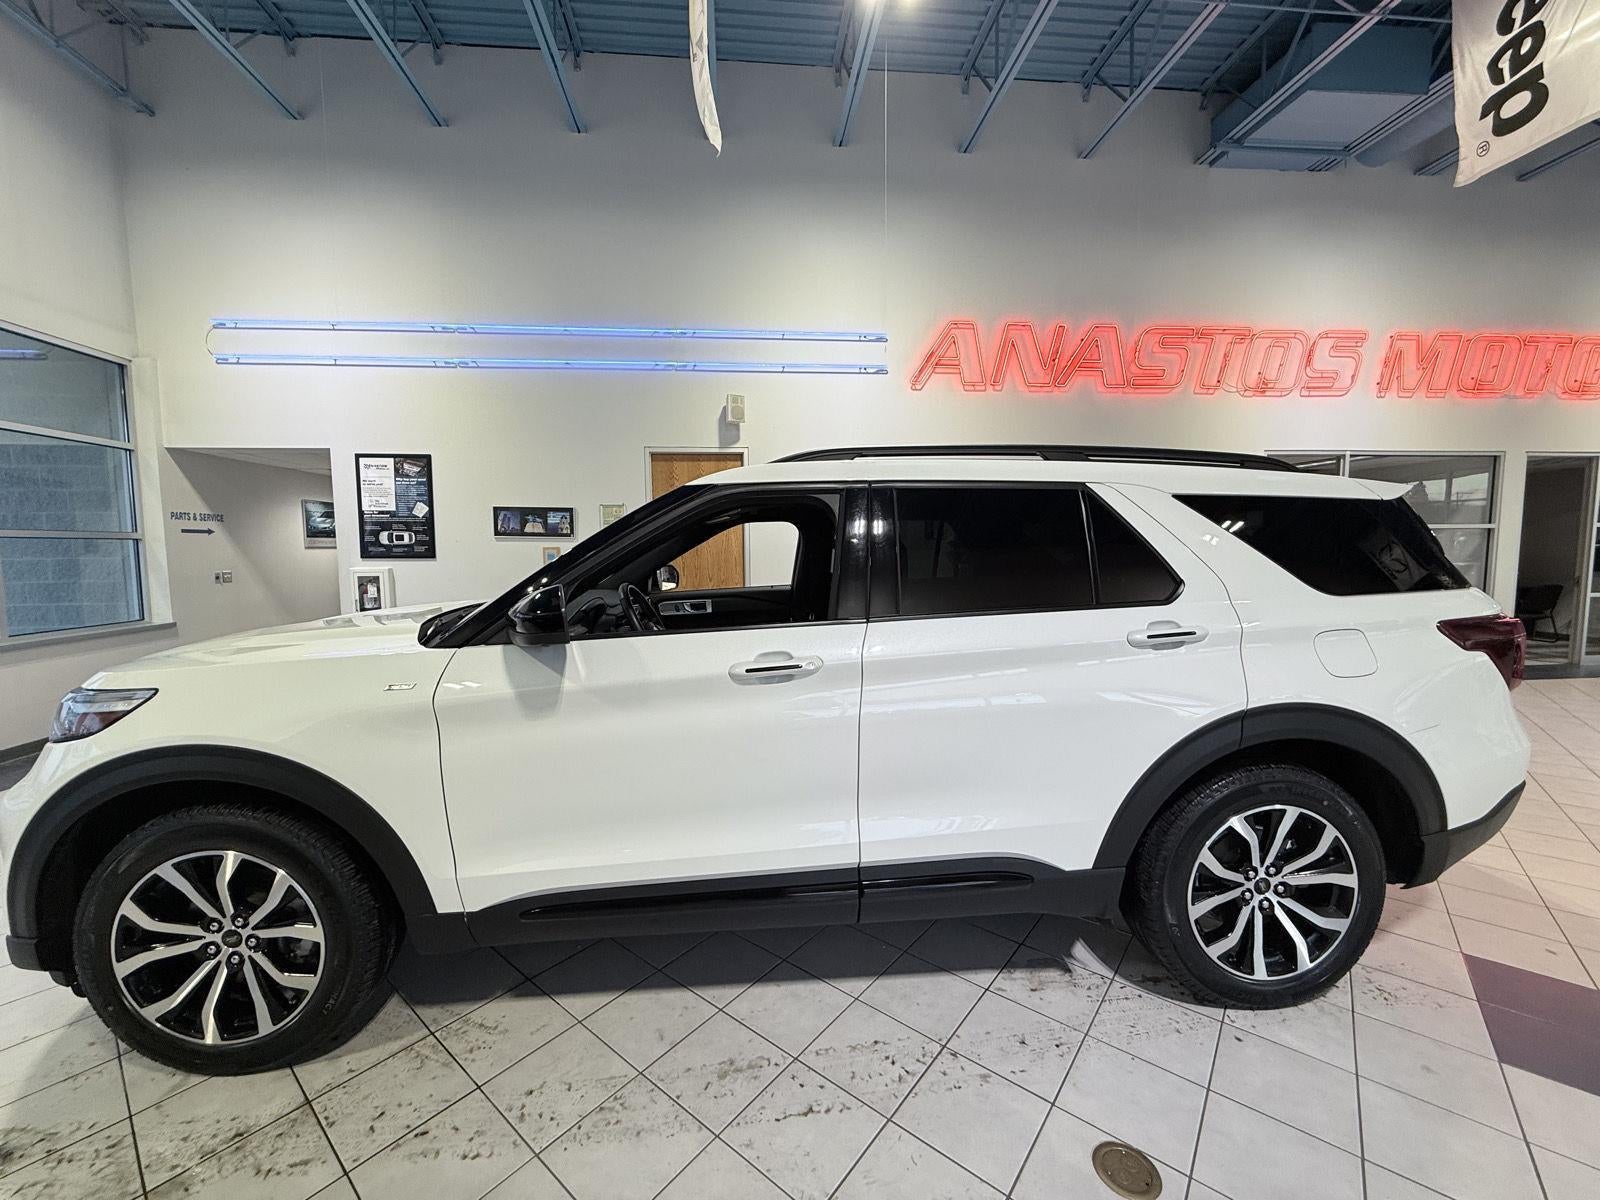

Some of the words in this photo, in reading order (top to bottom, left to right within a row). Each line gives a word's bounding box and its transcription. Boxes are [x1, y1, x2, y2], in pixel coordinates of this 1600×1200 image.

[910, 321, 1369, 393] ANASTOS
[170, 511, 191, 521] PARTS
[192, 512, 198, 521] &
[199, 512, 224, 523] SERVICE
